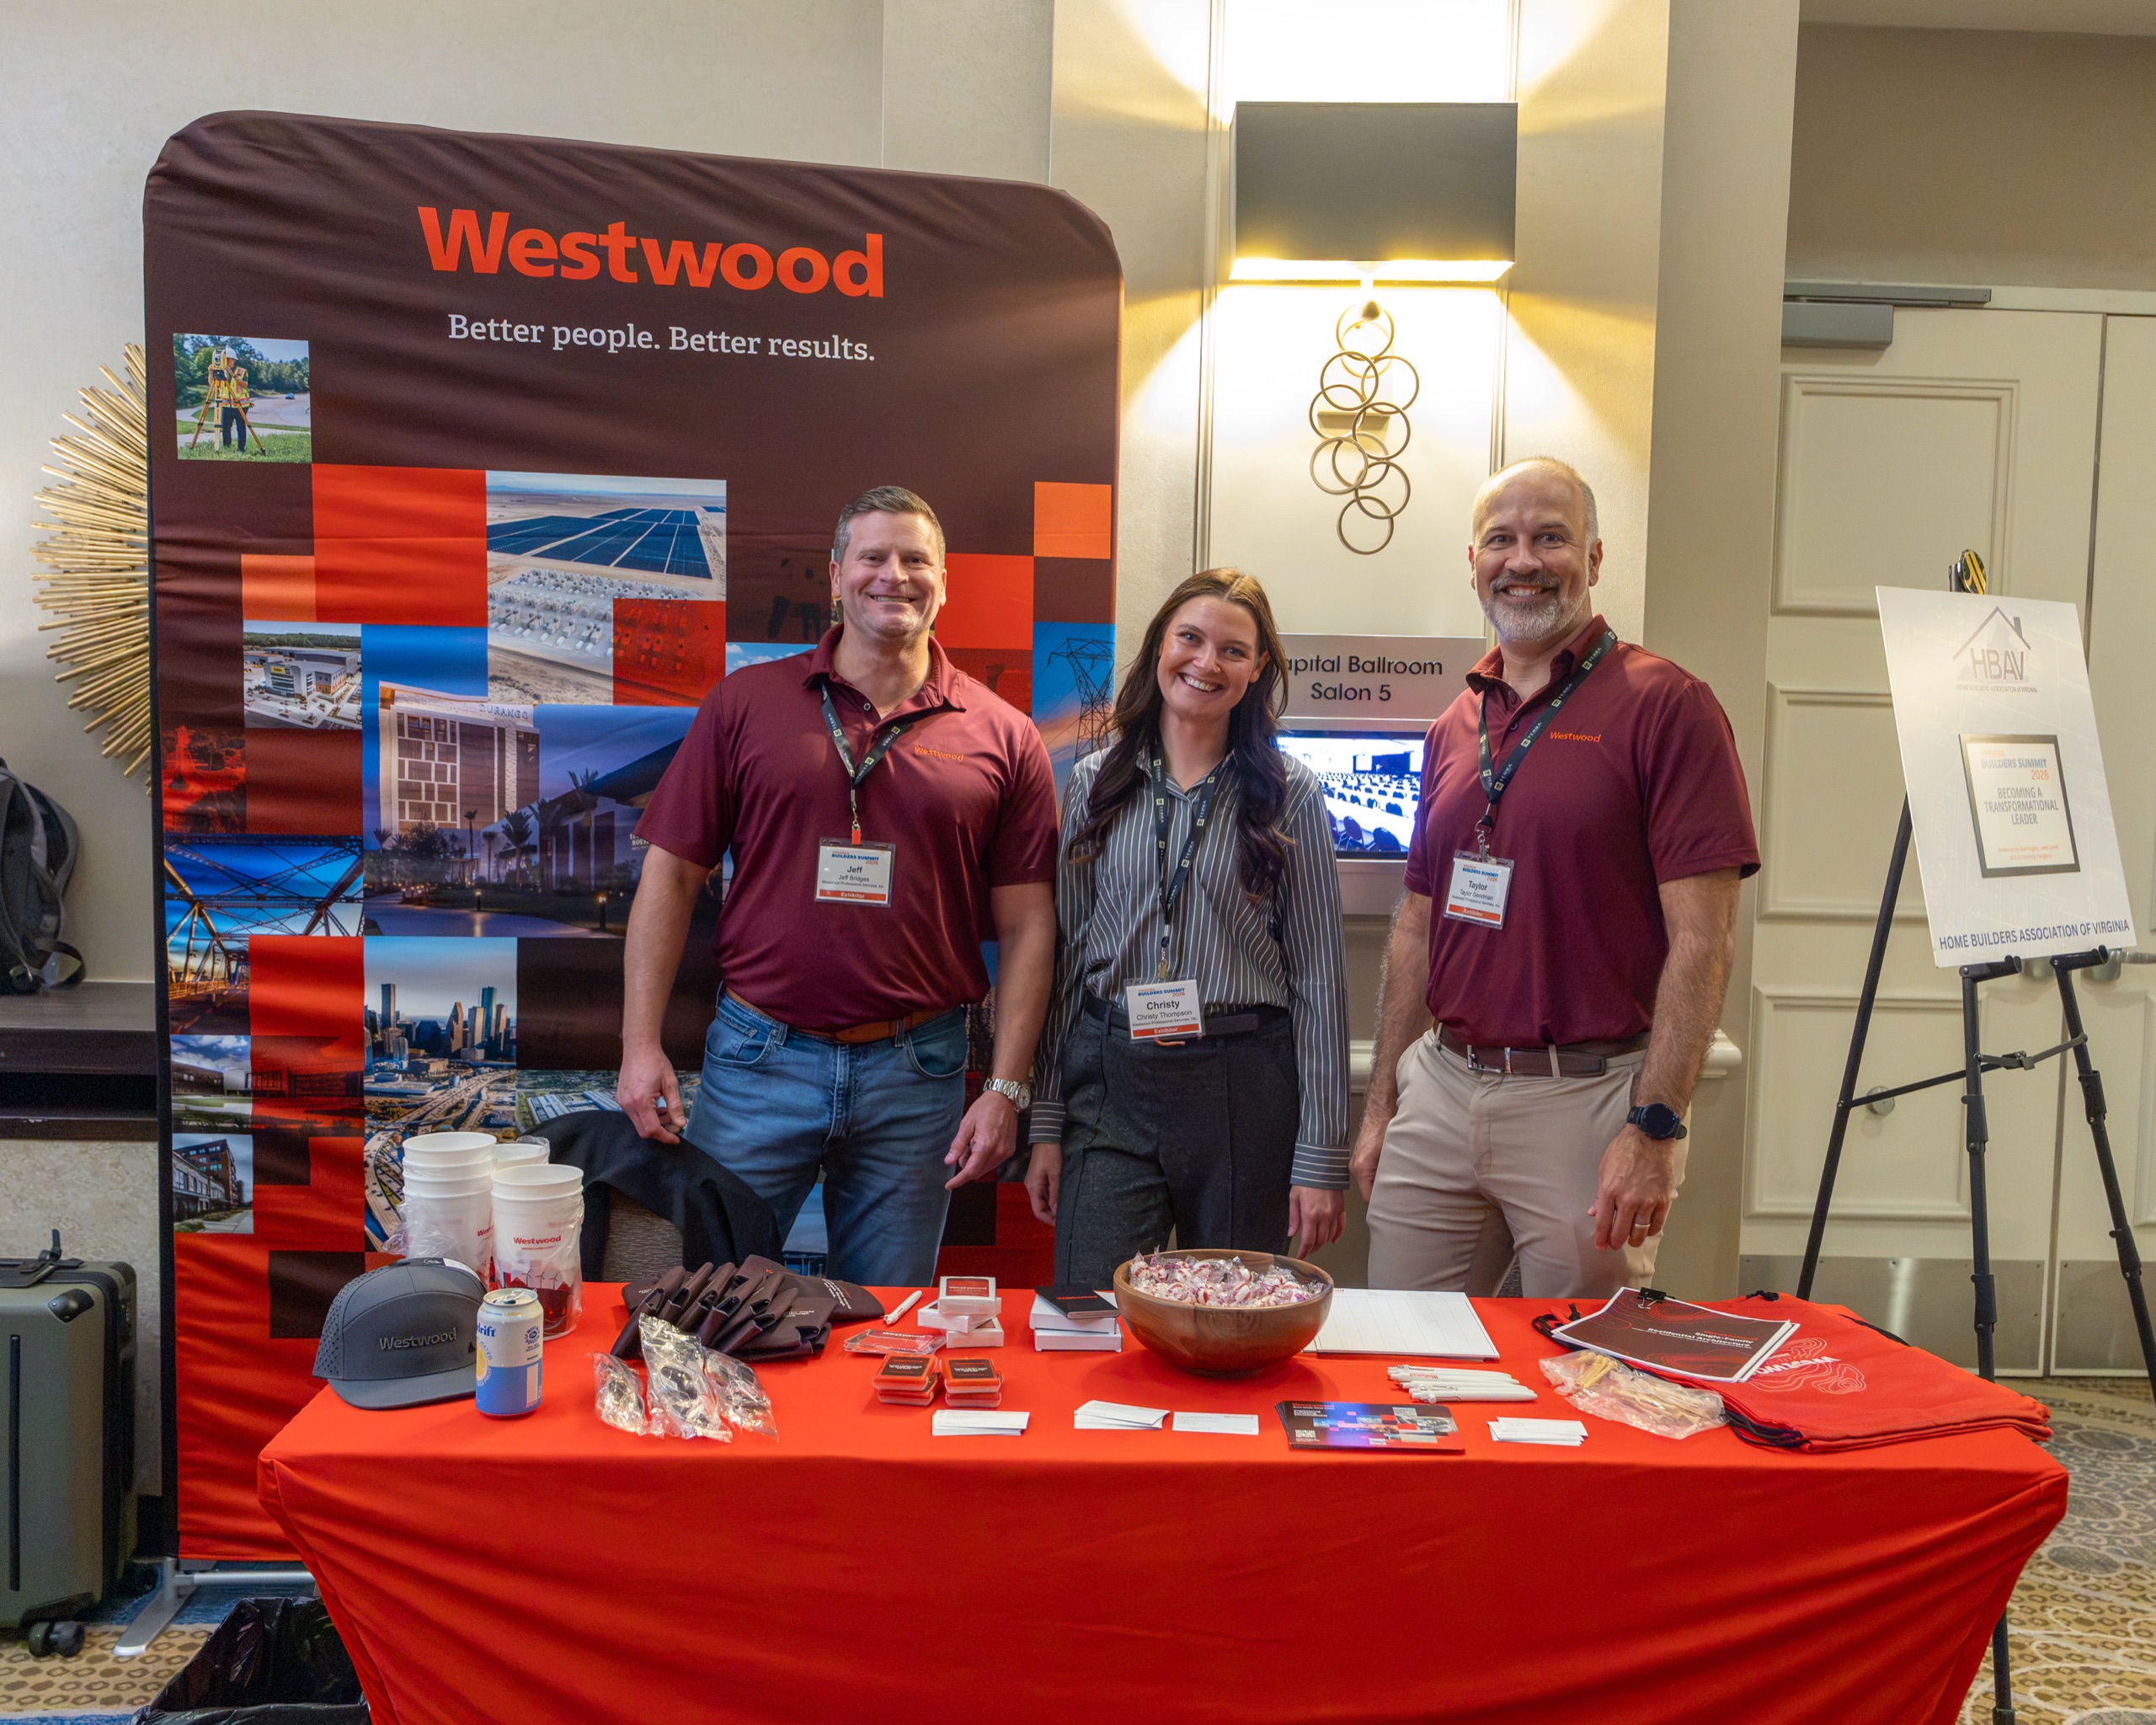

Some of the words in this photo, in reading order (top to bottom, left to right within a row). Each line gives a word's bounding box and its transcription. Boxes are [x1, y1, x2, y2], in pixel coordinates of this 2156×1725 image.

[418, 206, 883, 297] Westwood
[448, 313, 544, 343] Better
[552, 323, 661, 353] people.
[669, 326, 760, 355] Better
[767, 334, 876, 361] results.
[1284, 654, 1341, 676] apital
[1348, 655, 1443, 675] Ballroom
[1970, 648, 2024, 681] HBAV
[1310, 681, 1371, 702] Salon
[1379, 684, 1392, 702] 5
[479, 703, 529, 720] DURANGO
[1550, 731, 1601, 743] Westwood
[914, 745, 964, 762] Westwood
[1981, 758, 2017, 769] BUILDERS
[2018, 758, 2047, 769] SUMMIT
[2031, 769, 2050, 781] 2026
[1997, 787, 2036, 799] BECOMING
[2037, 787, 2043, 798] A
[1984, 799, 2059, 813] TRANSFORMATIONAL
[2011, 813, 2039, 825] LEADER
[847, 865, 863, 873] Jeff
[1469, 880, 1488, 891] Taylor
[1460, 889, 1472, 897] Taylor
[1472, 892, 1494, 900] Goodman
[1939, 934, 1970, 950] HOME
[1971, 930, 2018, 947] BUILDERS
[2020, 924, 2079, 942] ASSOCIATION
[2079, 922, 2091, 936] OF
[2092, 919, 2130, 935] VIRGINIA
[1146, 1000, 1180, 1011] Christy
[1160, 1010, 1193, 1018] Thompson
[513, 1235, 562, 1245] Westwood
[379, 1326, 456, 1350] Westwood
[1647, 1327, 1695, 1339] Residential
[1696, 1336, 1751, 1347] Architecture
[1694, 1332, 1754, 1344] Single-Family
